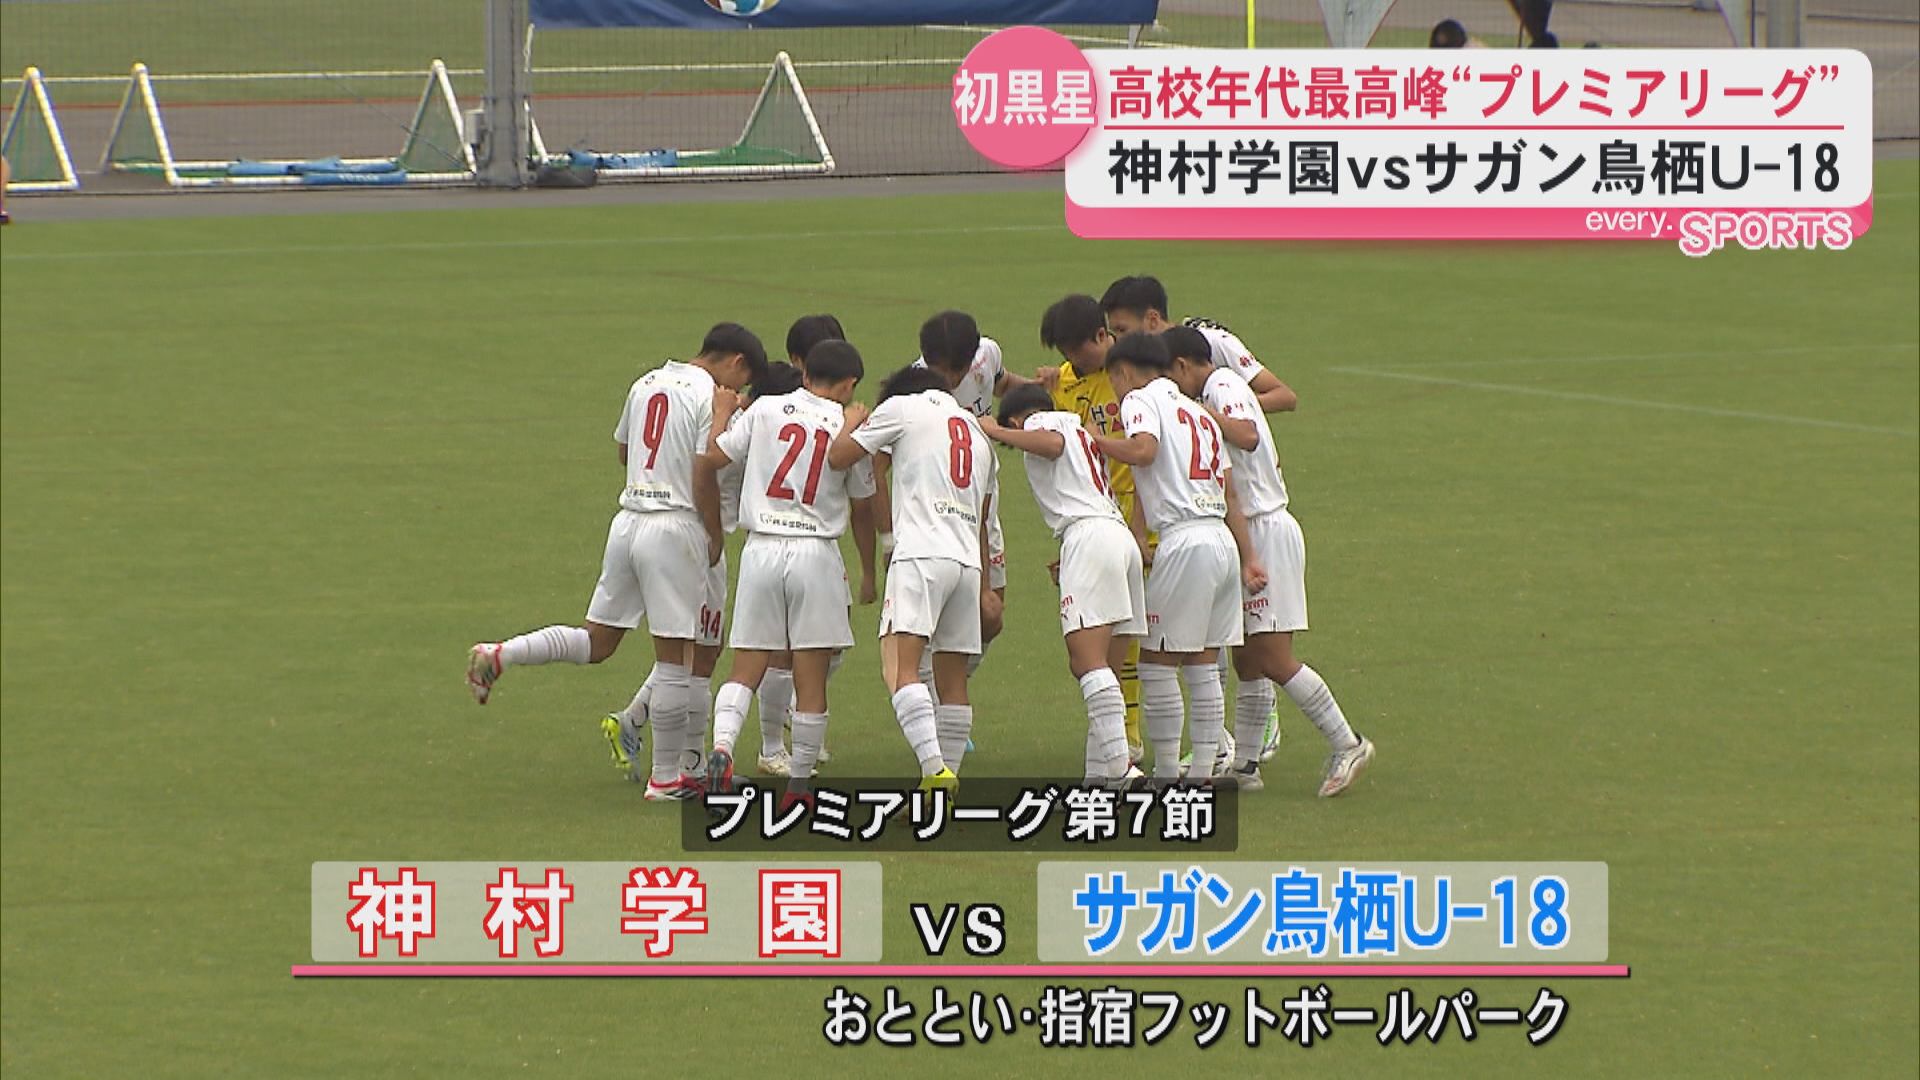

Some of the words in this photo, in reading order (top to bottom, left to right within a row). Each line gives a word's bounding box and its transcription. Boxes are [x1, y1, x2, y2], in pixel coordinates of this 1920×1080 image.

[643, 392, 669, 470] 9
[765, 422, 831, 506] 21
[947, 415, 973, 490] 8
[1177, 407, 1224, 489] 22
